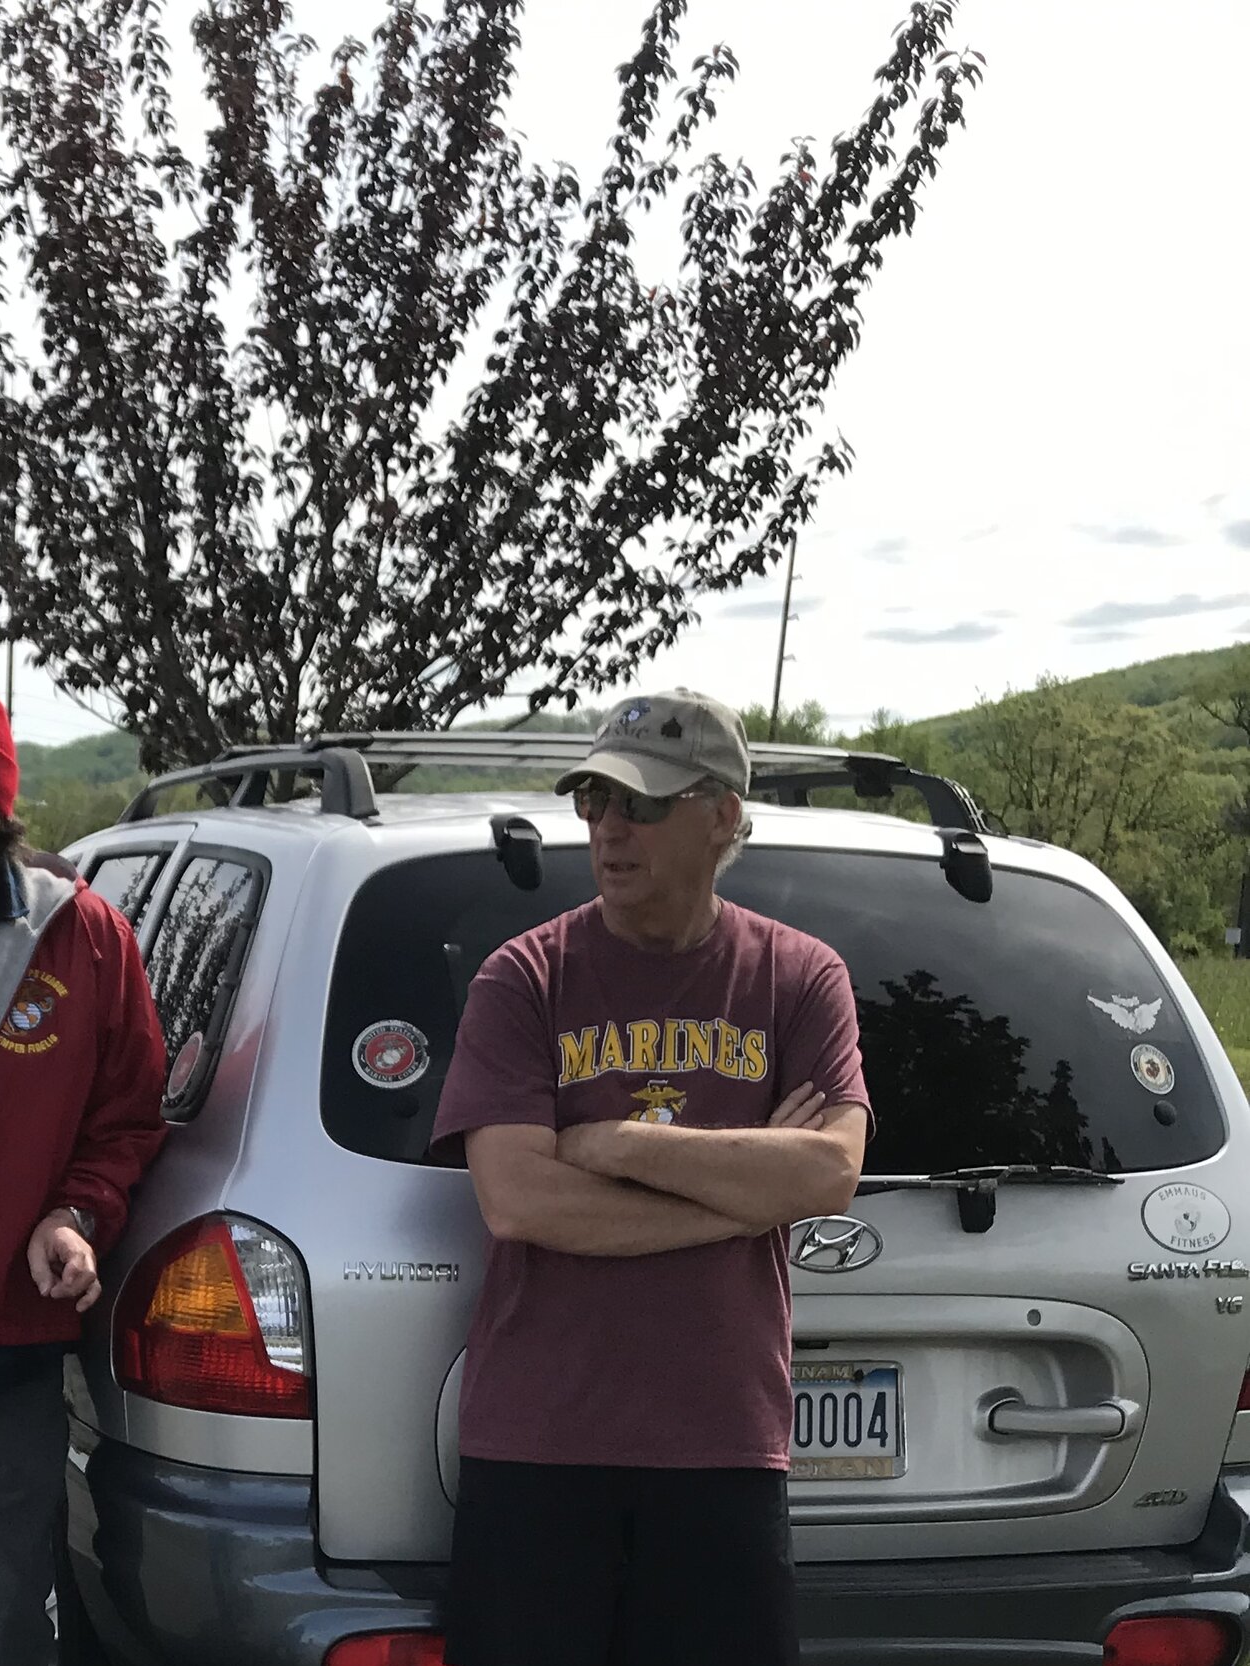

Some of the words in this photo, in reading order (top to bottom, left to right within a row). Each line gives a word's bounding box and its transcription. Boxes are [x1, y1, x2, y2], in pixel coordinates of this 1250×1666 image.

[558, 1018, 768, 1087] MARINES
[364, 1066, 393, 1081] MARINE
[1158, 1186, 1207, 1201] EMMAUS
[1170, 1232, 1217, 1248] FITNESS
[343, 1260, 459, 1282] HYUNDAI
[1127, 1261, 1201, 1280] SANTA
[794, 1391, 889, 1449] 0004
